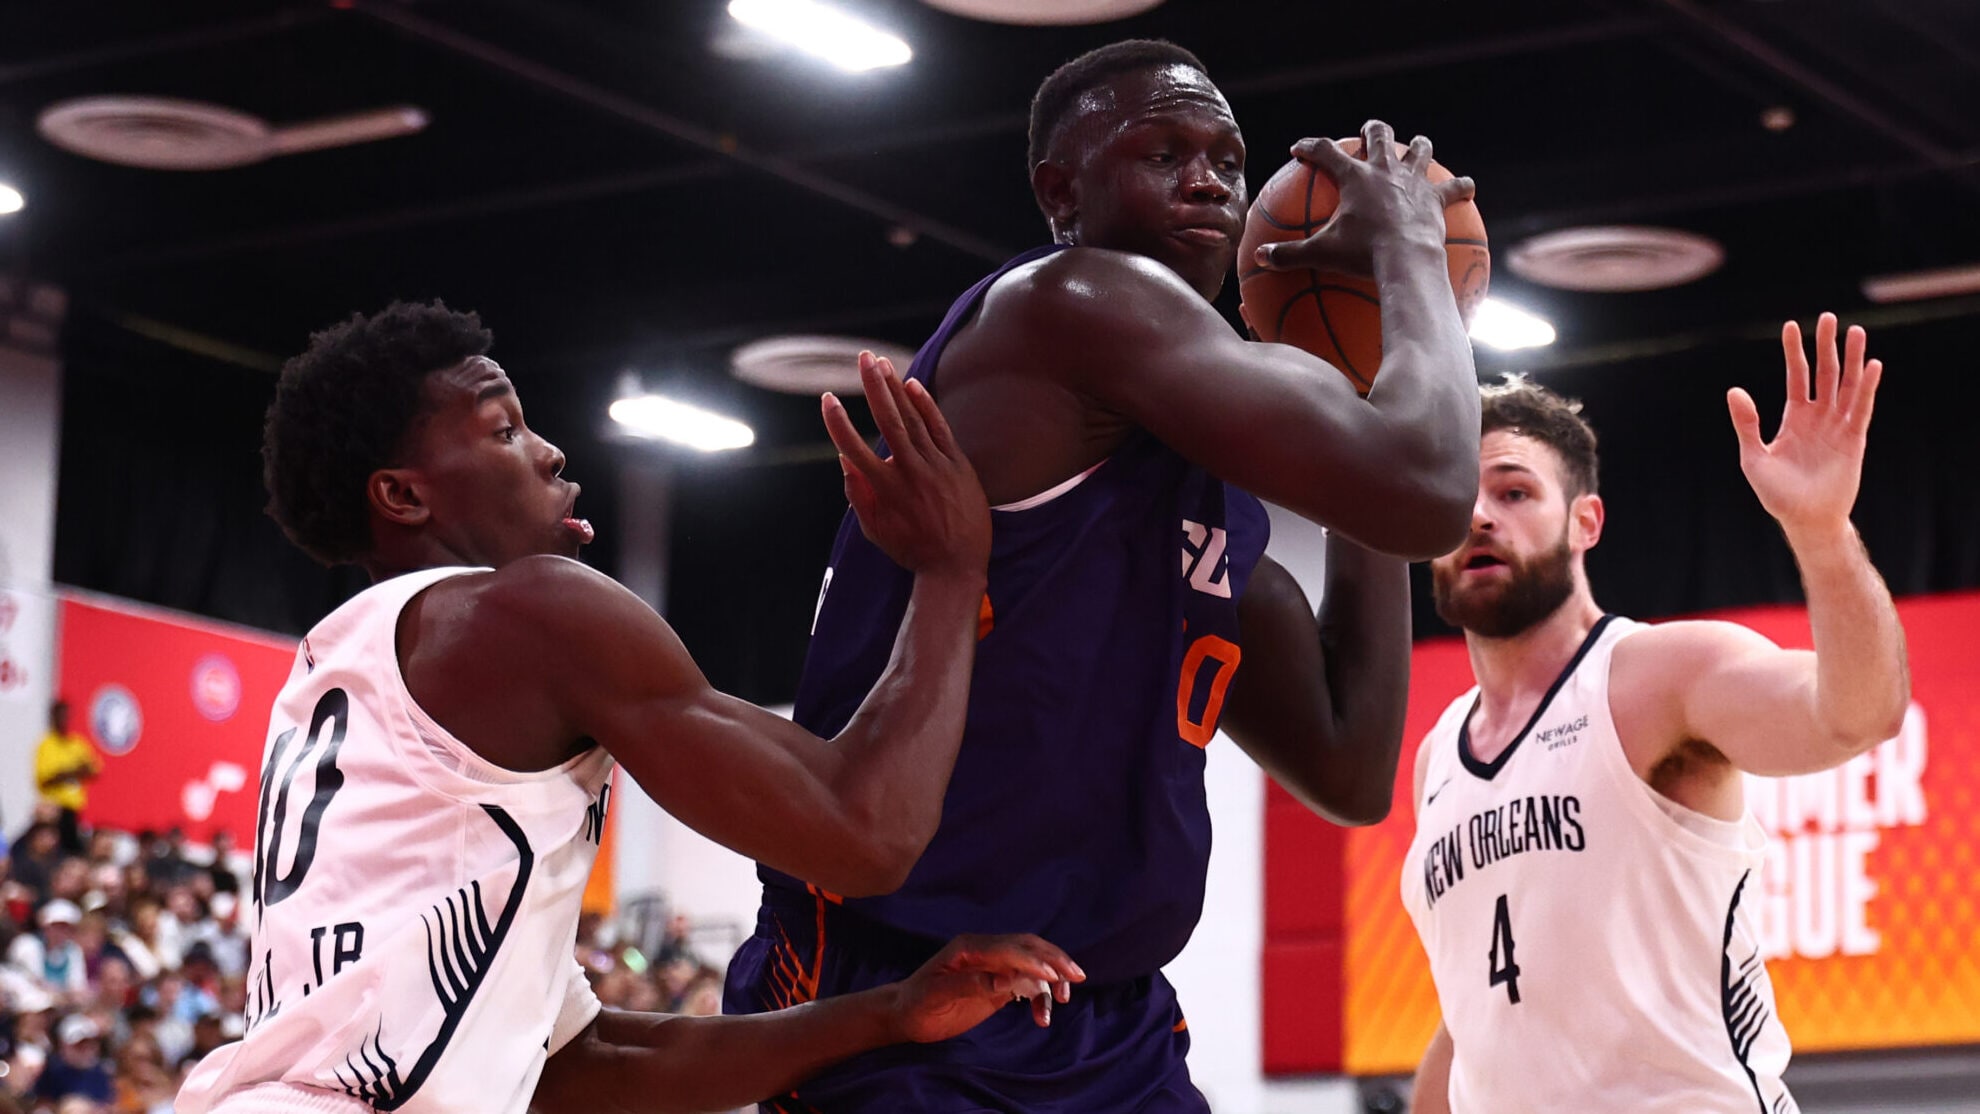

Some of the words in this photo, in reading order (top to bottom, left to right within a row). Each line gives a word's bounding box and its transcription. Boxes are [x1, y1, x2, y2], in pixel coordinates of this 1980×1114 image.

[1177, 617, 1241, 749] 0
[1536, 714, 1589, 744] NEWAGE
[1424, 824, 1464, 910] NEW
[1469, 795, 1585, 870] ORLEANS
[1489, 894, 1521, 1004] 4
